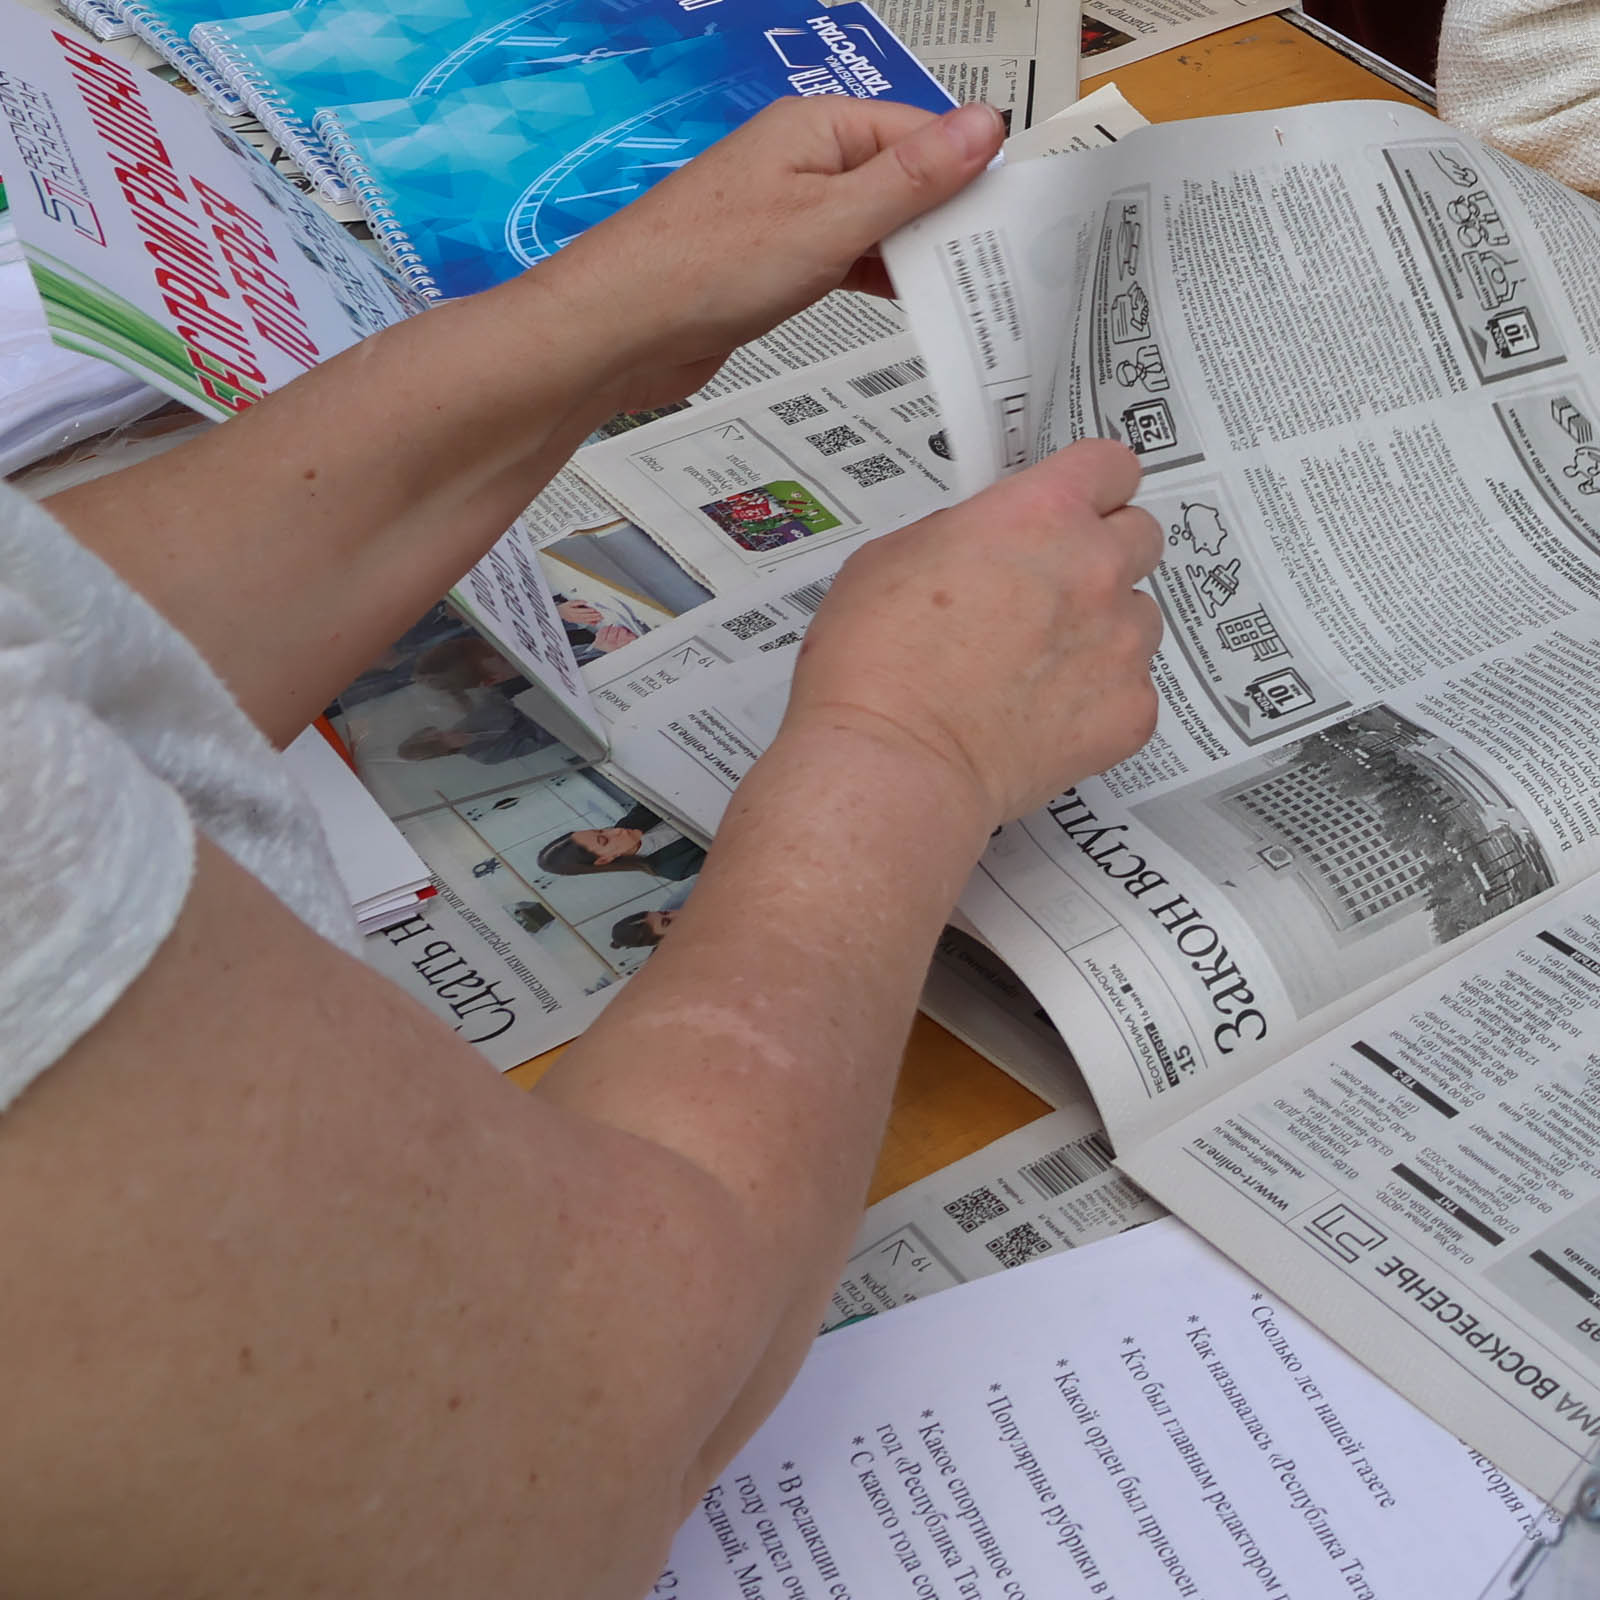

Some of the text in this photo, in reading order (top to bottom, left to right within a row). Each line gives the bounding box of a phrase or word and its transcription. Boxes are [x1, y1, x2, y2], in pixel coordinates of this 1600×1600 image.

[805, 11, 892, 97] ТАТАРСТАН
[823, 53, 870, 100] РЕСПУБЛИКА
[14, 76, 73, 180] ТАТАРСТАН
[639, 455, 664, 472] спорт
[1154, 674, 1219, 761] МЕНЯЕТСЯ ПОРЯДОК
[1161, 663, 1230, 757] КАПРЕМОНТА ОБЩЕГО
[457, 908, 562, 1014] Мошенники предлагают
[1045, 786, 1267, 1055] Закон вступ
[412, 941, 515, 1044] Сдать
[1084, 958, 1166, 1094] РЕСПУБЛИКА ТАТАРСТАН
[1109, 964, 1180, 1082] четверг 16 мая 2024
[1174, 1045, 1196, 1072] 15
[1390, 1065, 1419, 1089] ТВ-3
[1193, 1138, 1288, 1211] www.rt-online.ru
[1213, 1126, 1279, 1176] info@rt-online.ru
[1433, 1191, 1460, 1215] ТНТ
[1375, 1256, 1560, 1400] ВОСКРЕСЕНЬЕ
[1186, 1326, 1215, 1360] Как
[1207, 1361, 1272, 1450] называлась
[1269, 1454, 1346, 1560] «Республика
[1252, 1306, 1395, 1507] Сколько лет нашей газете
[850, 1451, 921, 1573] С какого года
[876, 1424, 962, 1568] год «Республика
[918, 1422, 1012, 1578] Какое спортивное
[987, 1395, 1108, 1594] Популярные рубрики в
[1054, 1371, 1198, 1597] Какой орден был присвоен
[1120, 1348, 1281, 1592] Кто был главным редактором
[778, 1475, 839, 1581] В редакции
